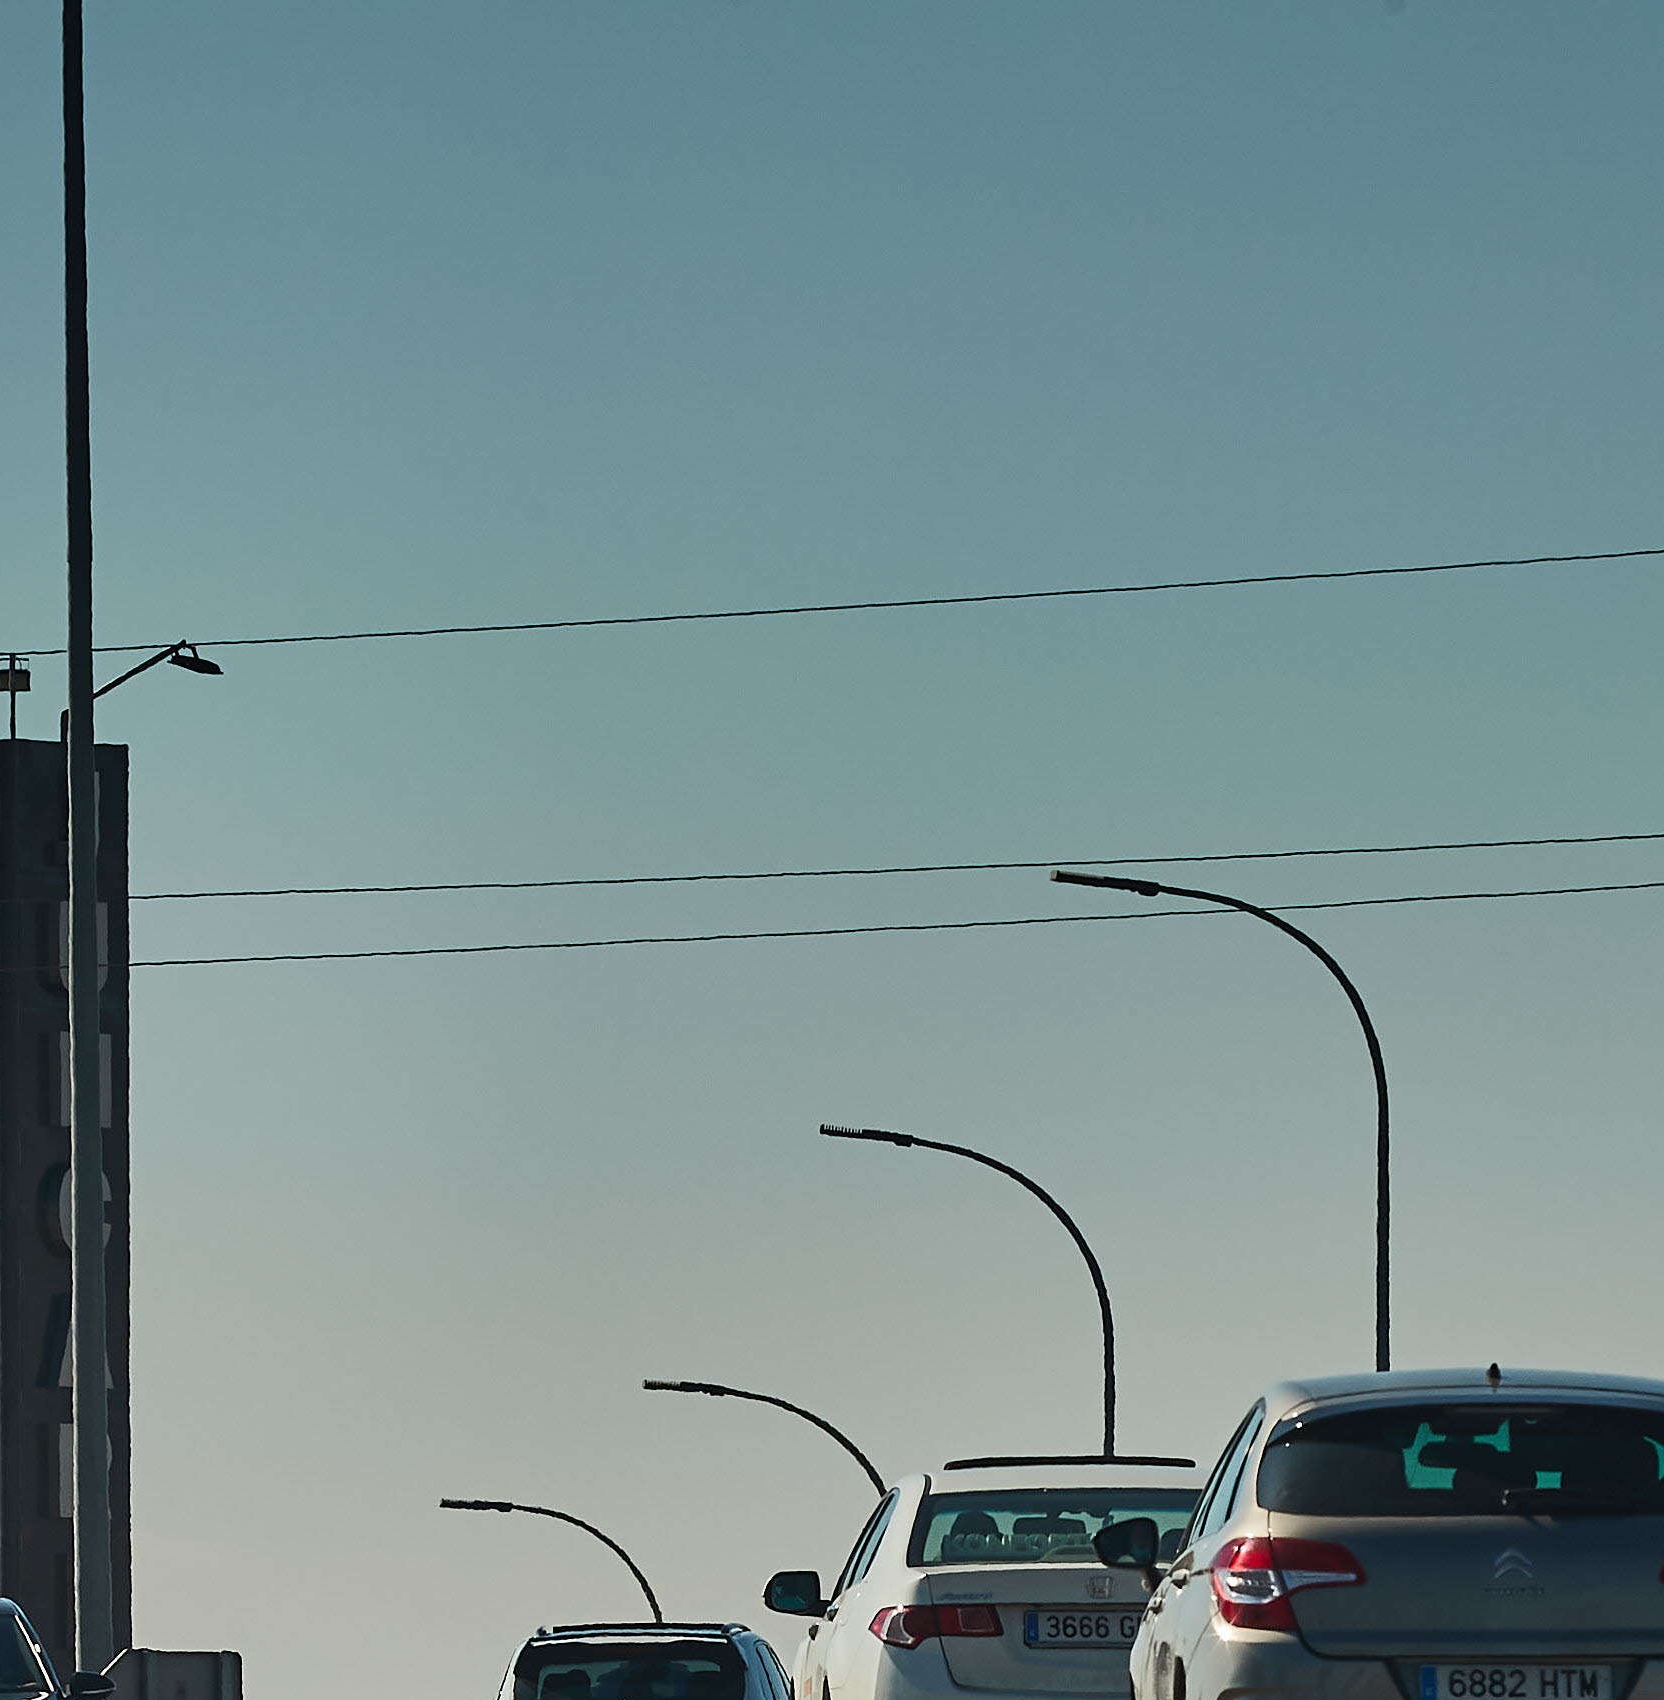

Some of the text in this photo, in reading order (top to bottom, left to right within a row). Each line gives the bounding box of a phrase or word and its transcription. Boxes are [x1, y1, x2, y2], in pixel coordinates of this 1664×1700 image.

[1046, 1615, 1141, 1639] 3666 G
[1448, 1669, 1599, 1698] 6882 HTM
